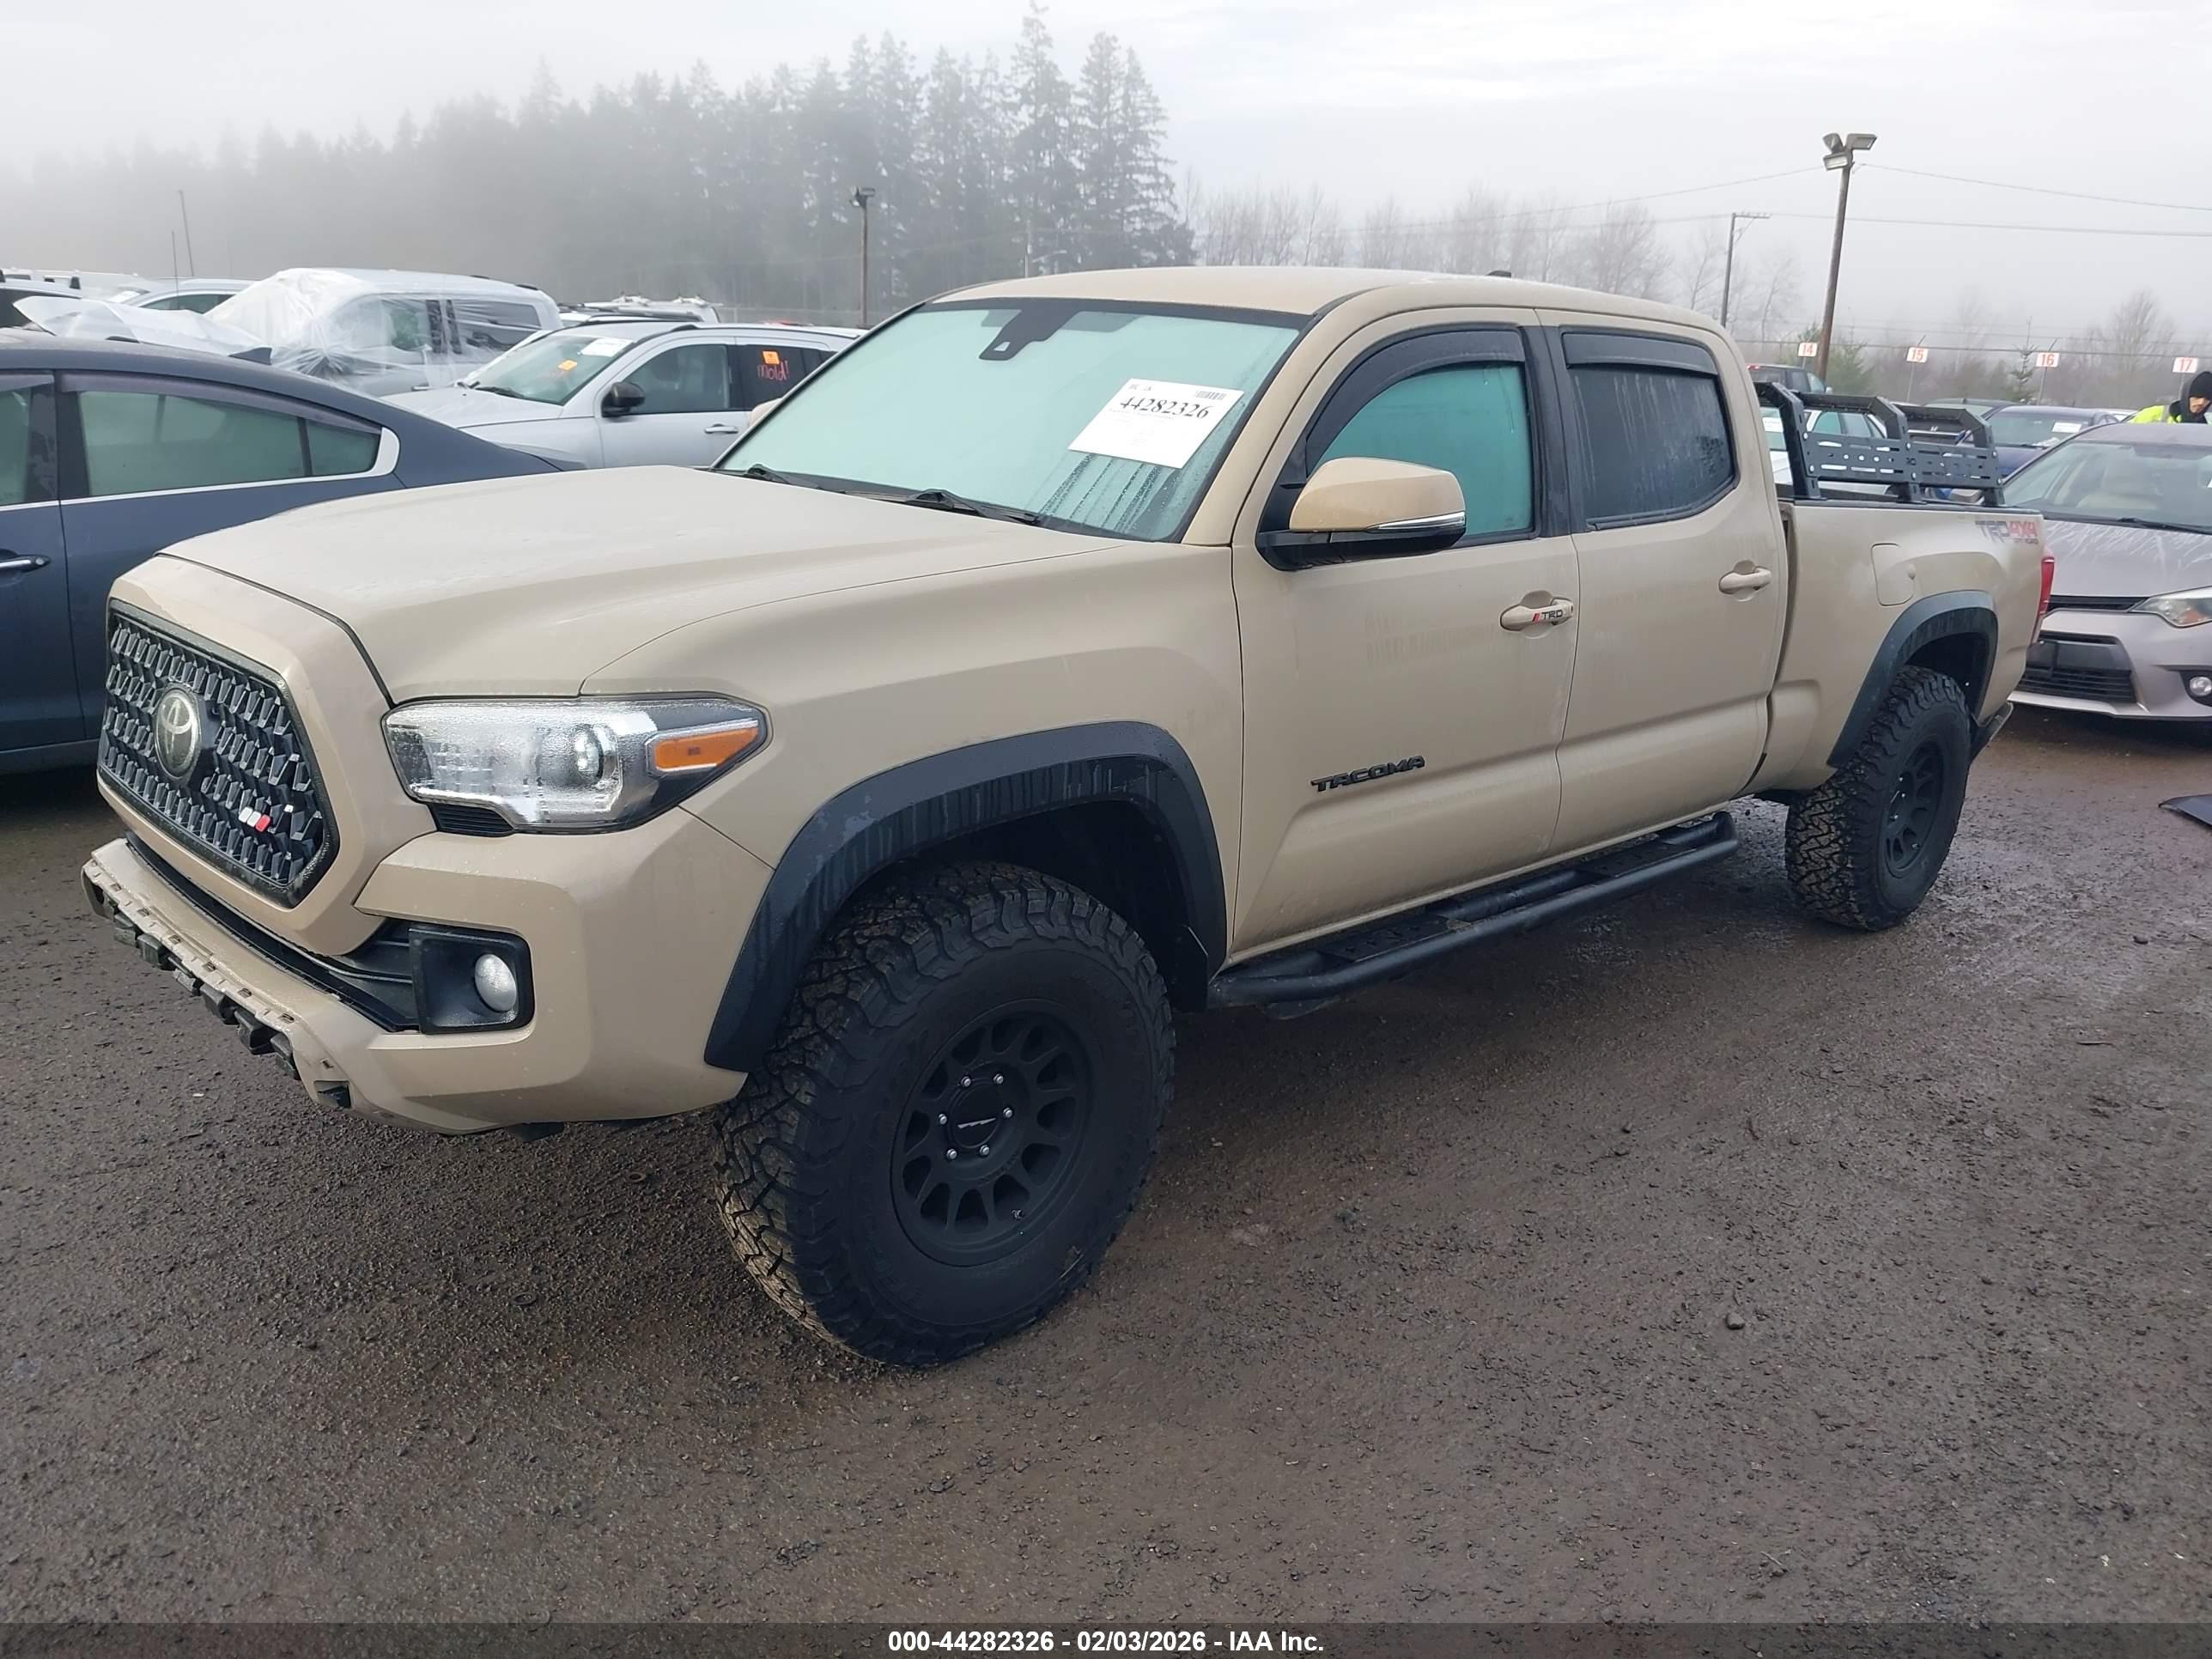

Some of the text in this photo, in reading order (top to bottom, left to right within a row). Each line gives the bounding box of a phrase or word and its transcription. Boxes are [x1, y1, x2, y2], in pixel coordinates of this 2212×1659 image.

[1803, 343, 1814, 356] 14
[1911, 349, 1923, 362] 15
[2041, 354, 2055, 366] 16
[2179, 359, 2193, 372] 17
[1120, 396, 1214, 419] 44282326
[1541, 609, 1563, 620] TRD
[1310, 755, 1425, 792] TACOMA
